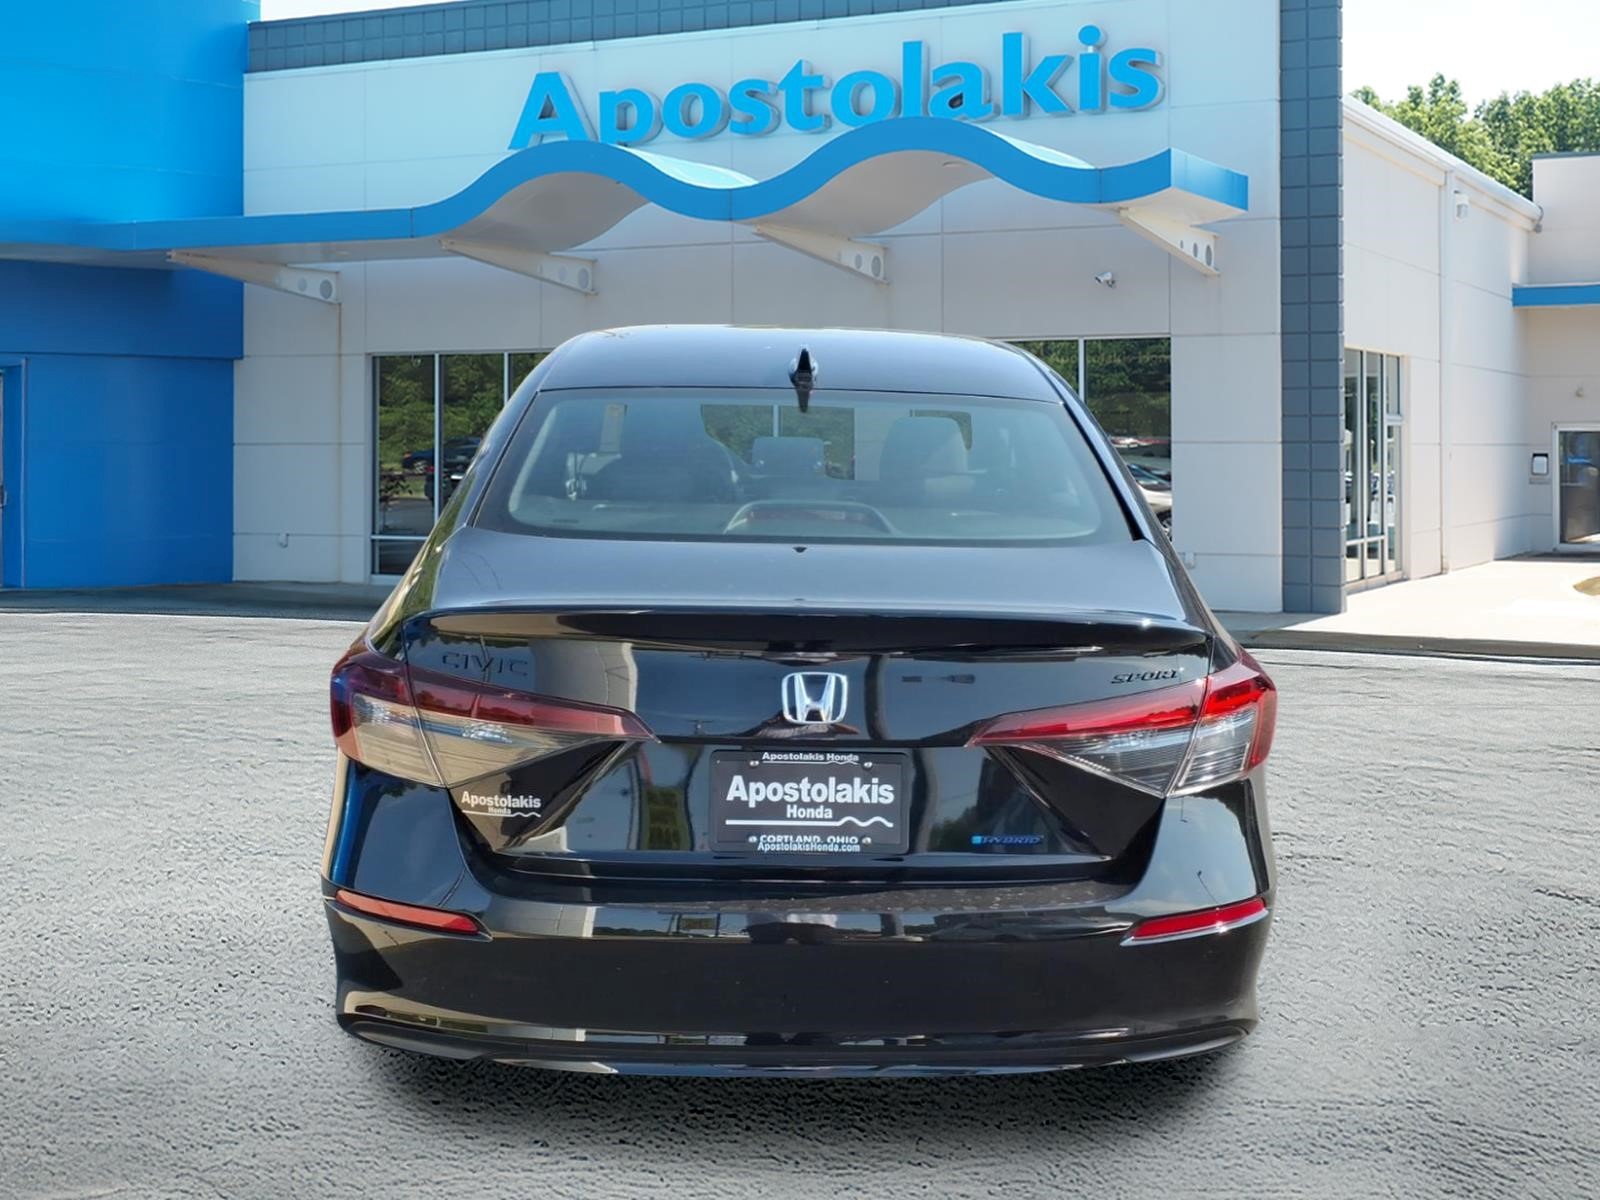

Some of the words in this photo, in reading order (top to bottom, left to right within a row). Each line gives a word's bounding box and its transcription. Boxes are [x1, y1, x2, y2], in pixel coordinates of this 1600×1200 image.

[508, 25, 1165, 149] Apostolakis
[442, 651, 528, 676] CIVIC
[1111, 669, 1177, 684] SPORT
[762, 752, 824, 761] Apostolakis
[826, 753, 859, 761] Honda
[726, 775, 894, 807] Apostolakis
[461, 791, 541, 808] Apostolakis
[786, 805, 833, 818] Honda
[757, 842, 861, 852] ApostolakisHonda.com
[983, 836, 1041, 844] HYBRID
